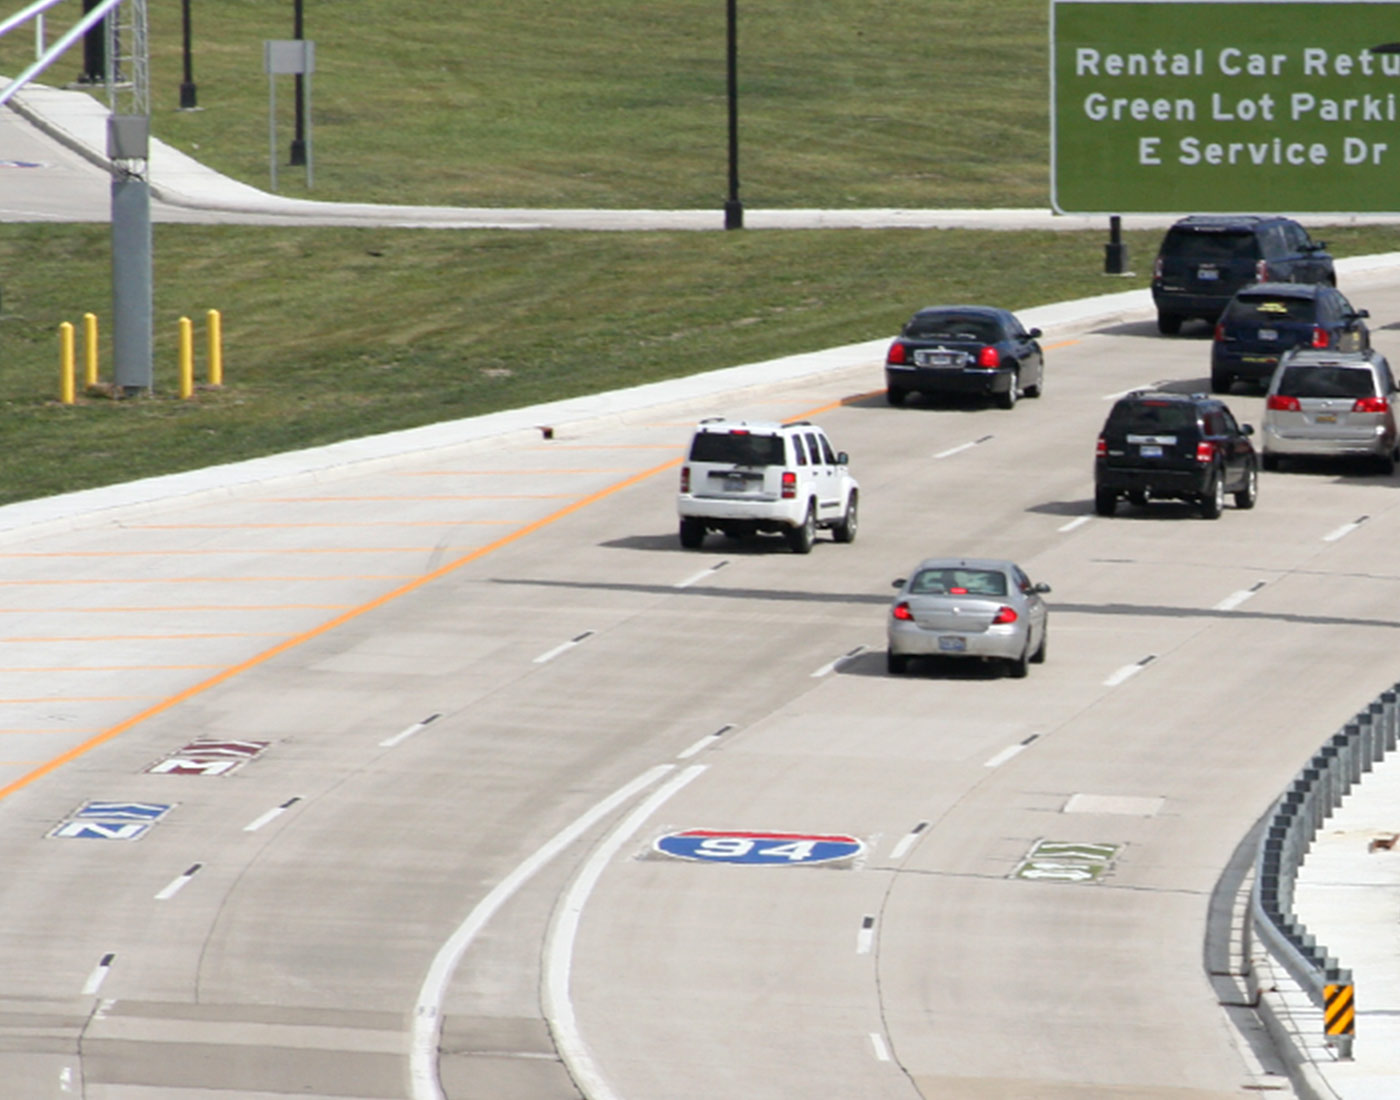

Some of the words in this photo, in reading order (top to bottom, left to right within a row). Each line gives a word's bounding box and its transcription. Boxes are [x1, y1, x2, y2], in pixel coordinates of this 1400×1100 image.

[1076, 48, 1203, 76] Rental
[1218, 48, 1287, 76] Car
[1084, 92, 1196, 121] Green
[1212, 93, 1275, 121] Lot
[1139, 137, 1162, 165] E
[1178, 136, 1329, 165] Service
[1343, 137, 1388, 165] Dr
[694, 838, 818, 861] 94
